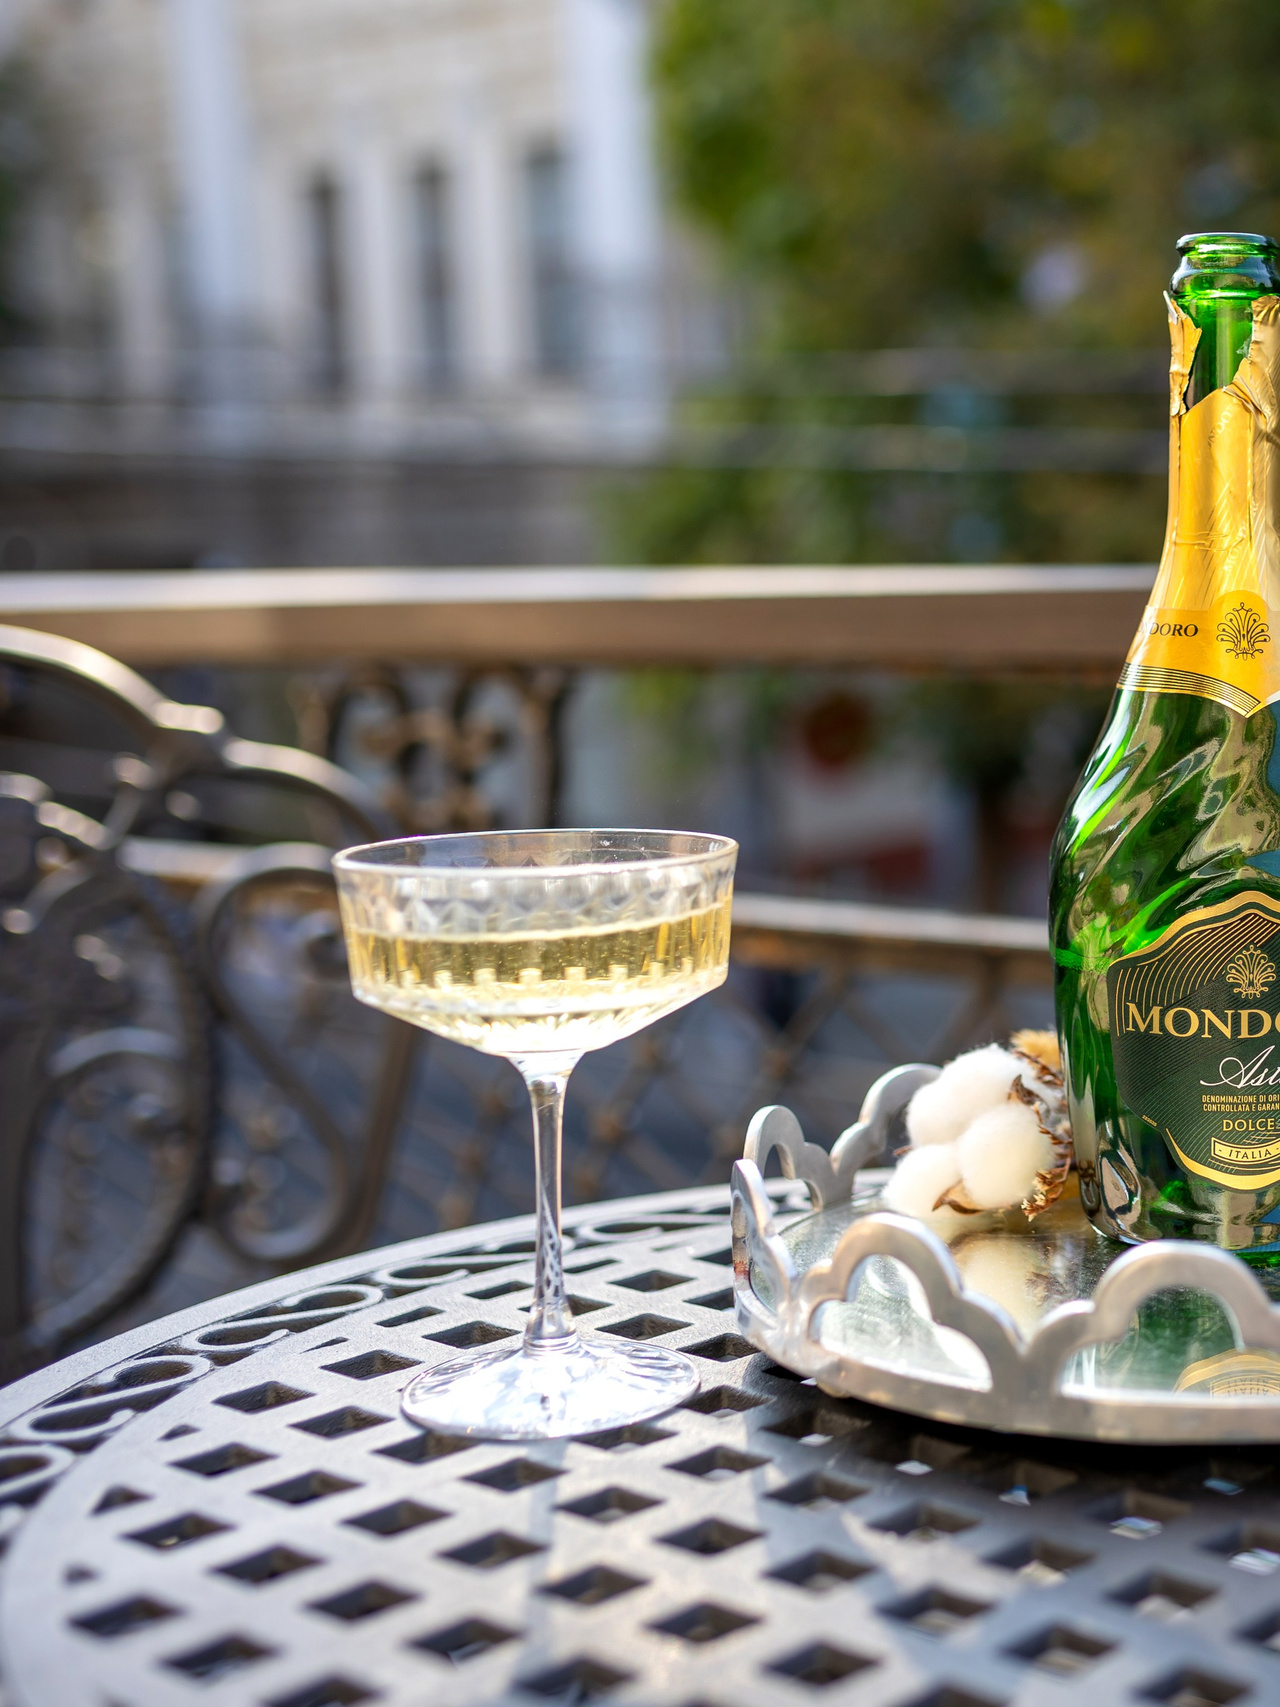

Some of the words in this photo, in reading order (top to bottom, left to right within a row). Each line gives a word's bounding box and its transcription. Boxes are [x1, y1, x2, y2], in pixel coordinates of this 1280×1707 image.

[1202, 1094, 1257, 1103] DENOMINAZIONE
[1259, 1094, 1266, 1103] DI
[1203, 1103, 1250, 1112] CONTROLLATA
[1252, 1103, 1256, 1112] E
[1223, 1118, 1275, 1132] DOLCE
[1228, 1149, 1272, 1160] ITALIA
